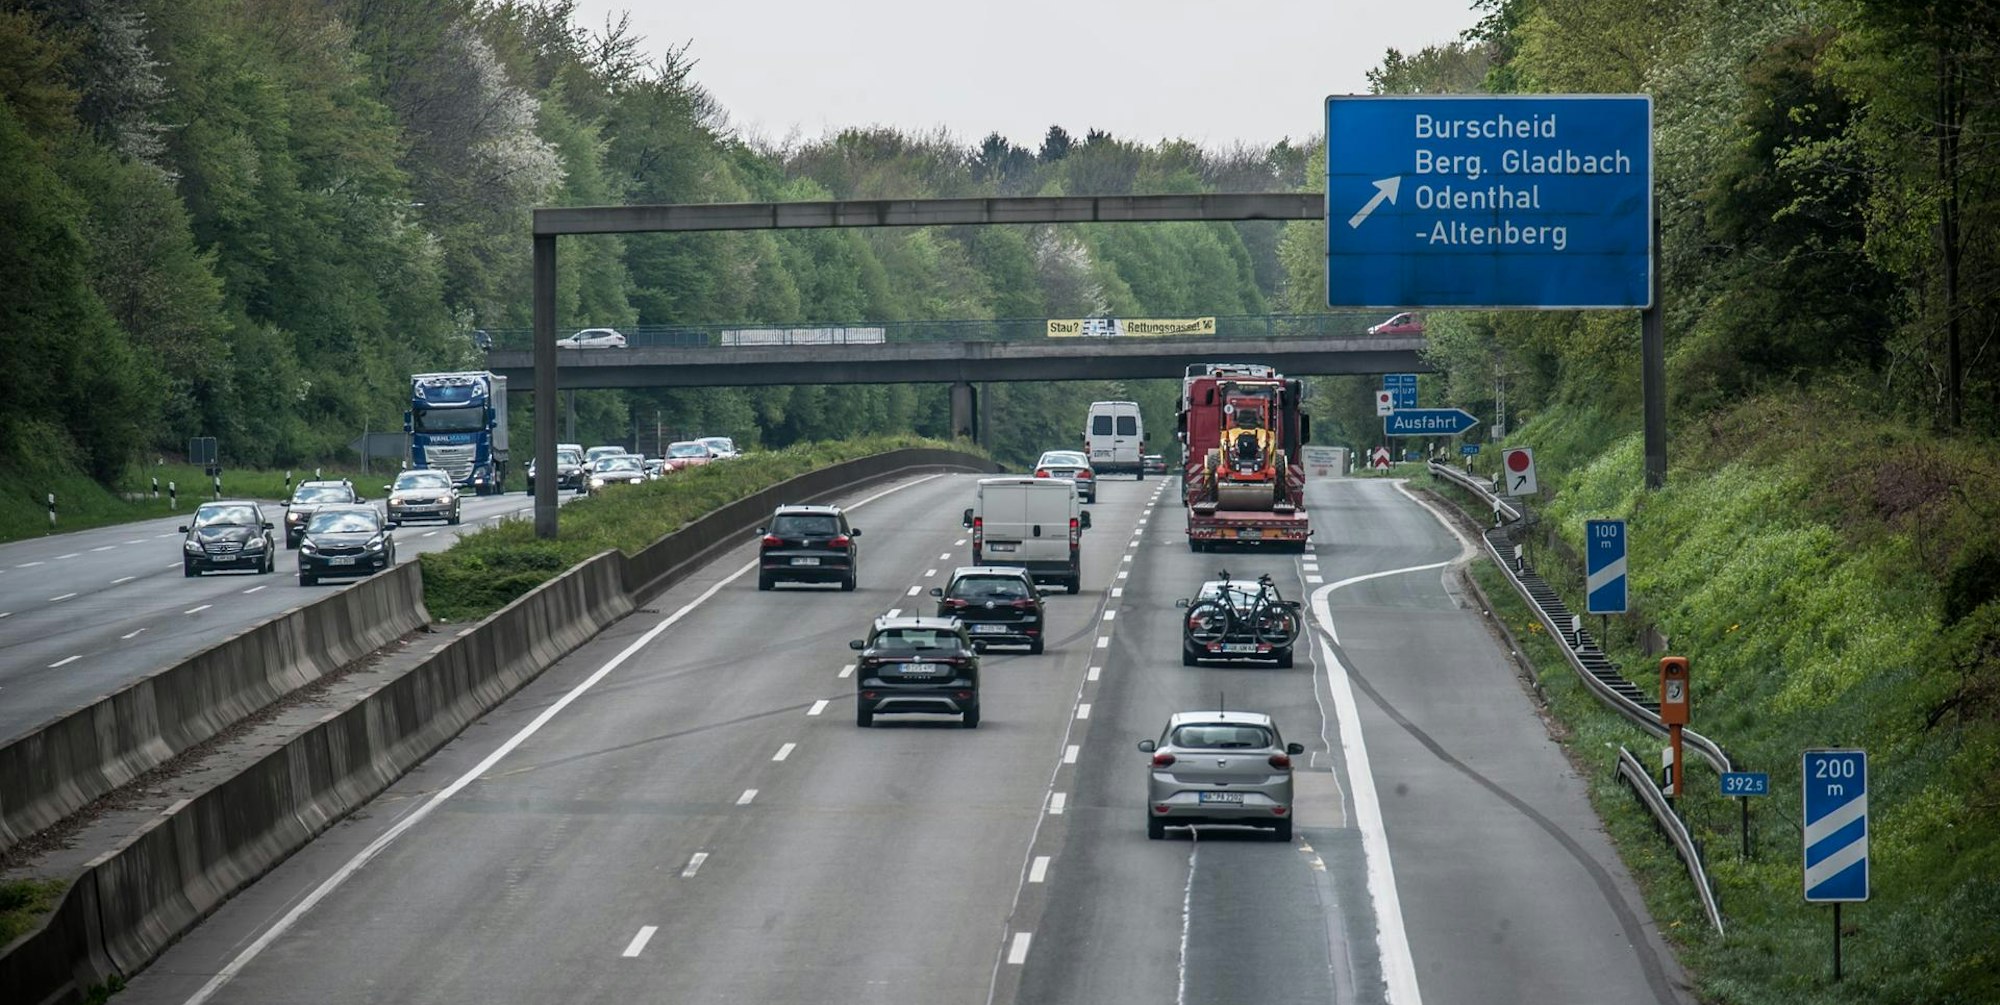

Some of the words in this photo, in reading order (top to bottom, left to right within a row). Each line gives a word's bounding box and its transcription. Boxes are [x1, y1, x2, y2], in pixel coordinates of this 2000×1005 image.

[1415, 114, 1556, 138] Burscheid
[1415, 149, 1488, 180] Berg.
[1501, 149, 1631, 174] Gladbach
[1415, 185, 1541, 210] Odenthal
[1415, 220, 1567, 250] -Altenberg
[1049, 321, 1079, 333] Stau?
[1394, 416, 1457, 429] Ausfahrt
[1595, 525, 1617, 538] 100
[1600, 540, 1611, 549] m
[1815, 759, 1855, 778] 200
[1726, 777, 1763, 791] 392.5
[1827, 783, 1843, 795] m
